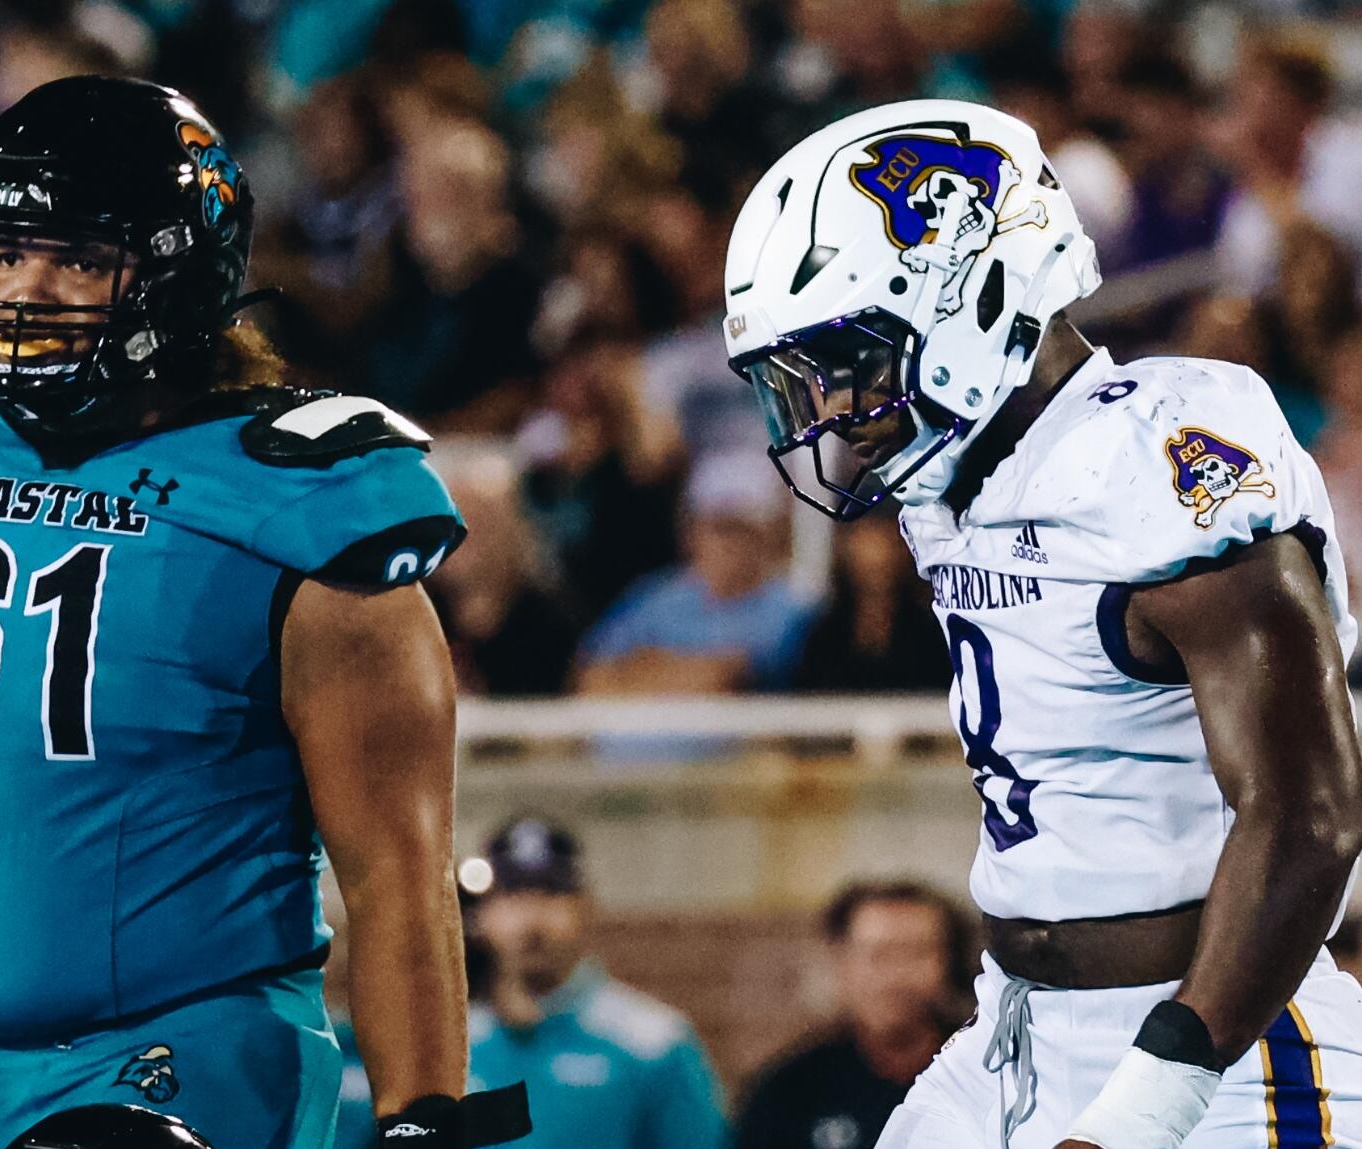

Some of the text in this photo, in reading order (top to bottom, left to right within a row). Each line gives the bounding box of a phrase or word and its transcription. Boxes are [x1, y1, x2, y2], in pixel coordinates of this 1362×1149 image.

[877, 147, 919, 192] ECU
[1178, 439, 1205, 463] ECU
[1011, 544, 1049, 564] adidas
[946, 613, 1039, 852] 8
